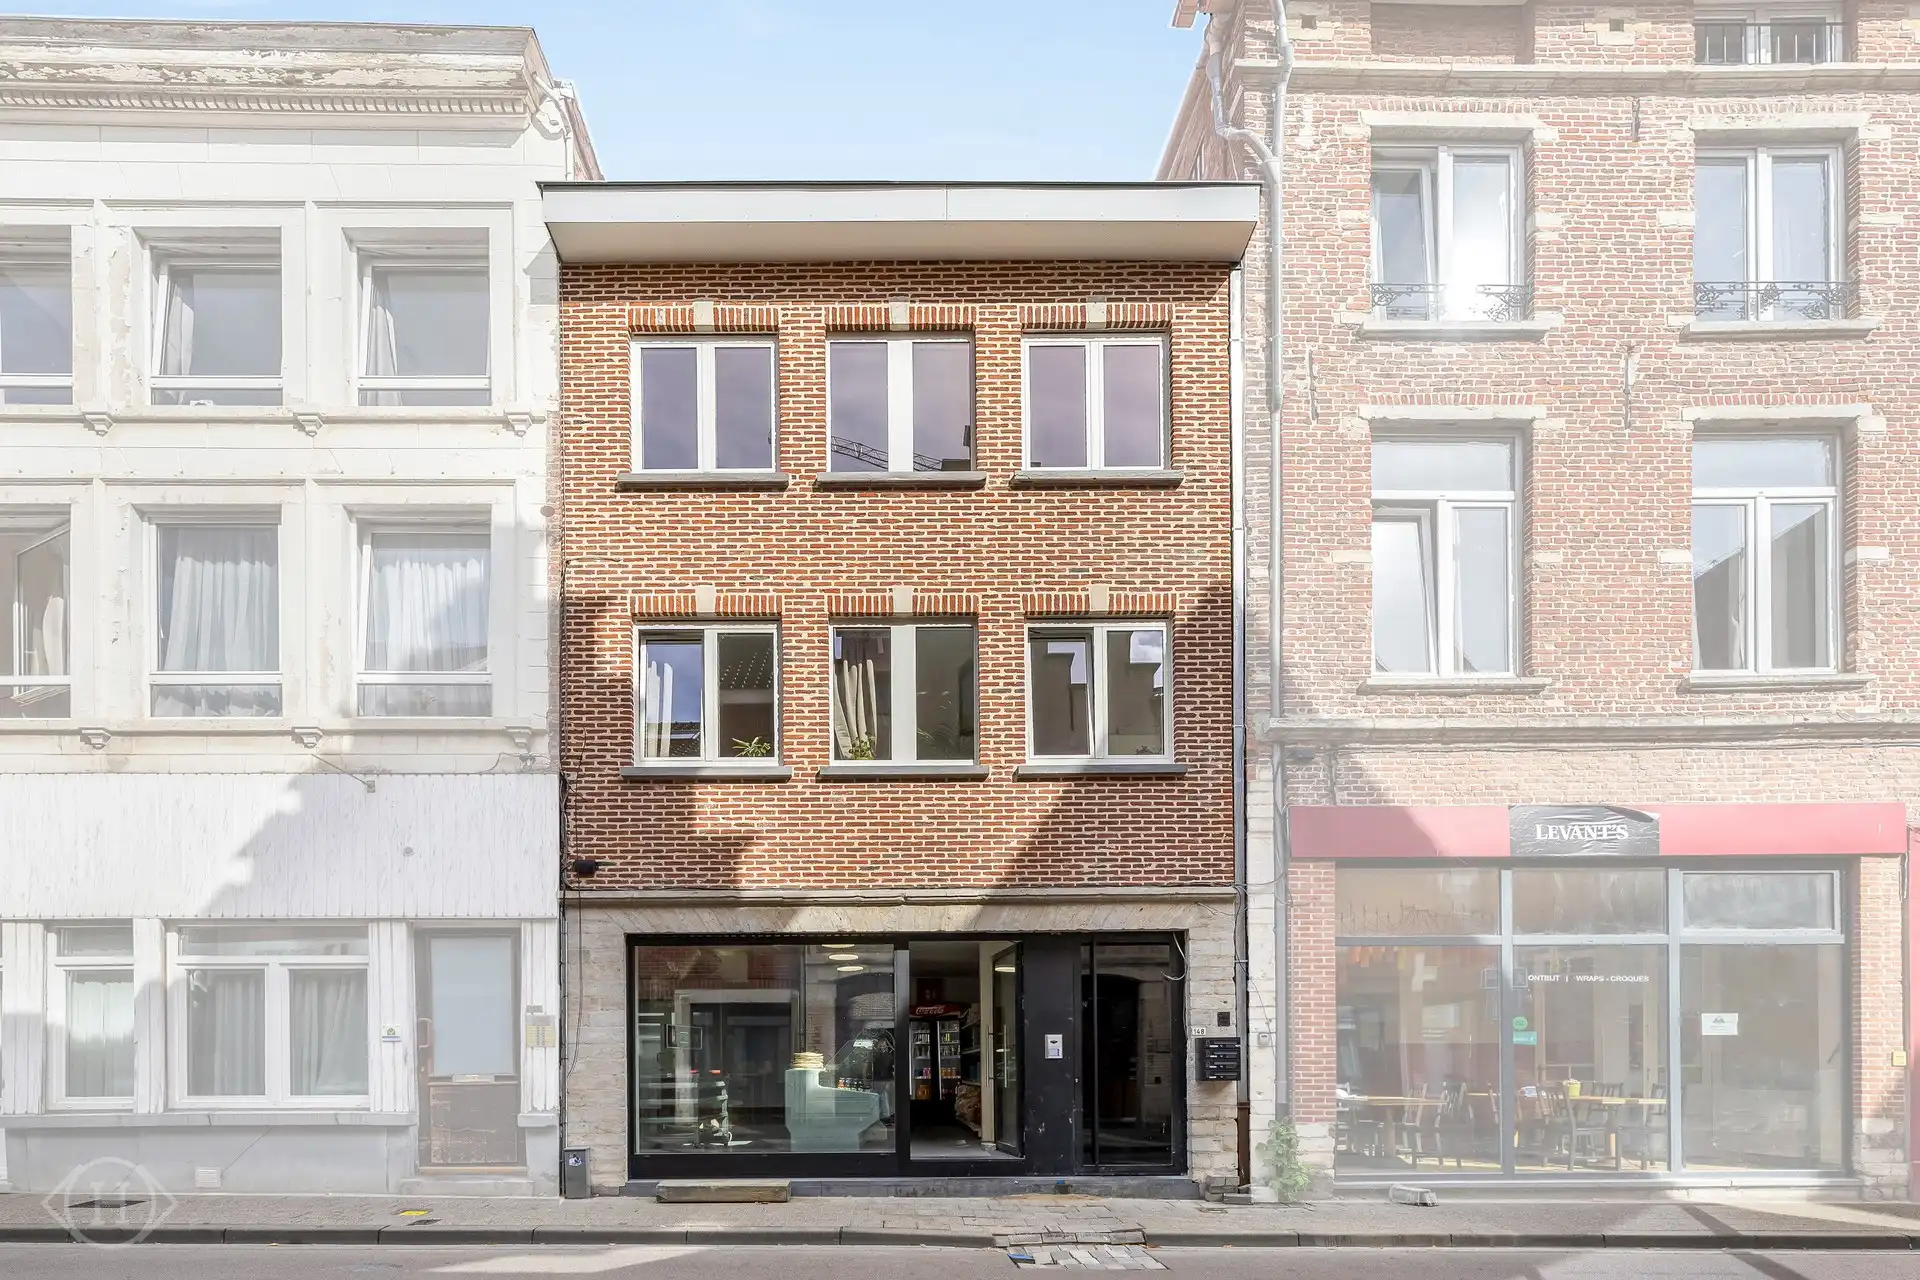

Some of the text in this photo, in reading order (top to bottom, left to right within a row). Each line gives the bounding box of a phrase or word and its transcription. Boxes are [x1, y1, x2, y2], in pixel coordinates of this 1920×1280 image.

[1534, 823, 1629, 841] LEVANT'S
[1575, 974, 1605, 982] WRAPS
[1610, 974, 1650, 982] CROQUES
